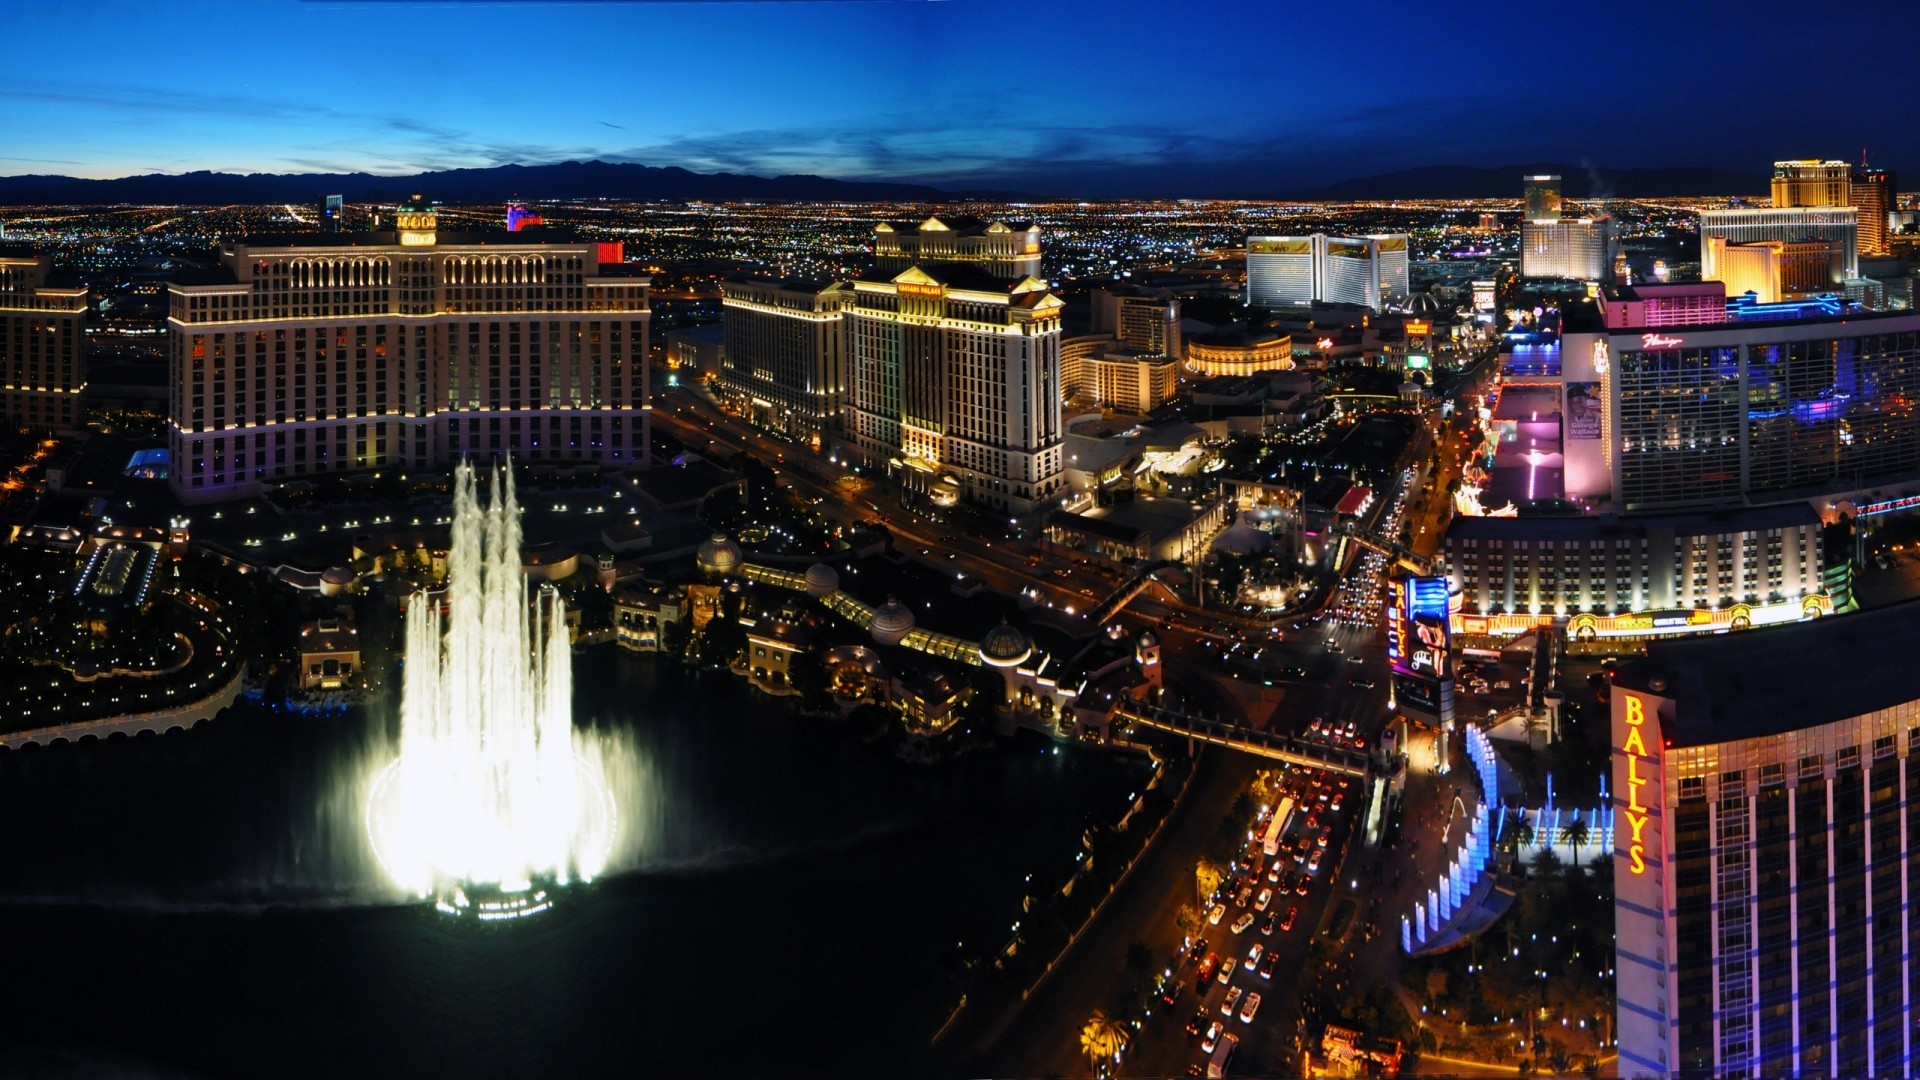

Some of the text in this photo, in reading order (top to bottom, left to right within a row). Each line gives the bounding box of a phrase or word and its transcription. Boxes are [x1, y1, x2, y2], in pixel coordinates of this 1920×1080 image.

[898, 285, 941, 296] CAESARS PALACE
[1641, 333, 1683, 348] Flamingo
[1395, 584, 1405, 657] BALLYS
[1623, 695, 1649, 875] BALLYS
